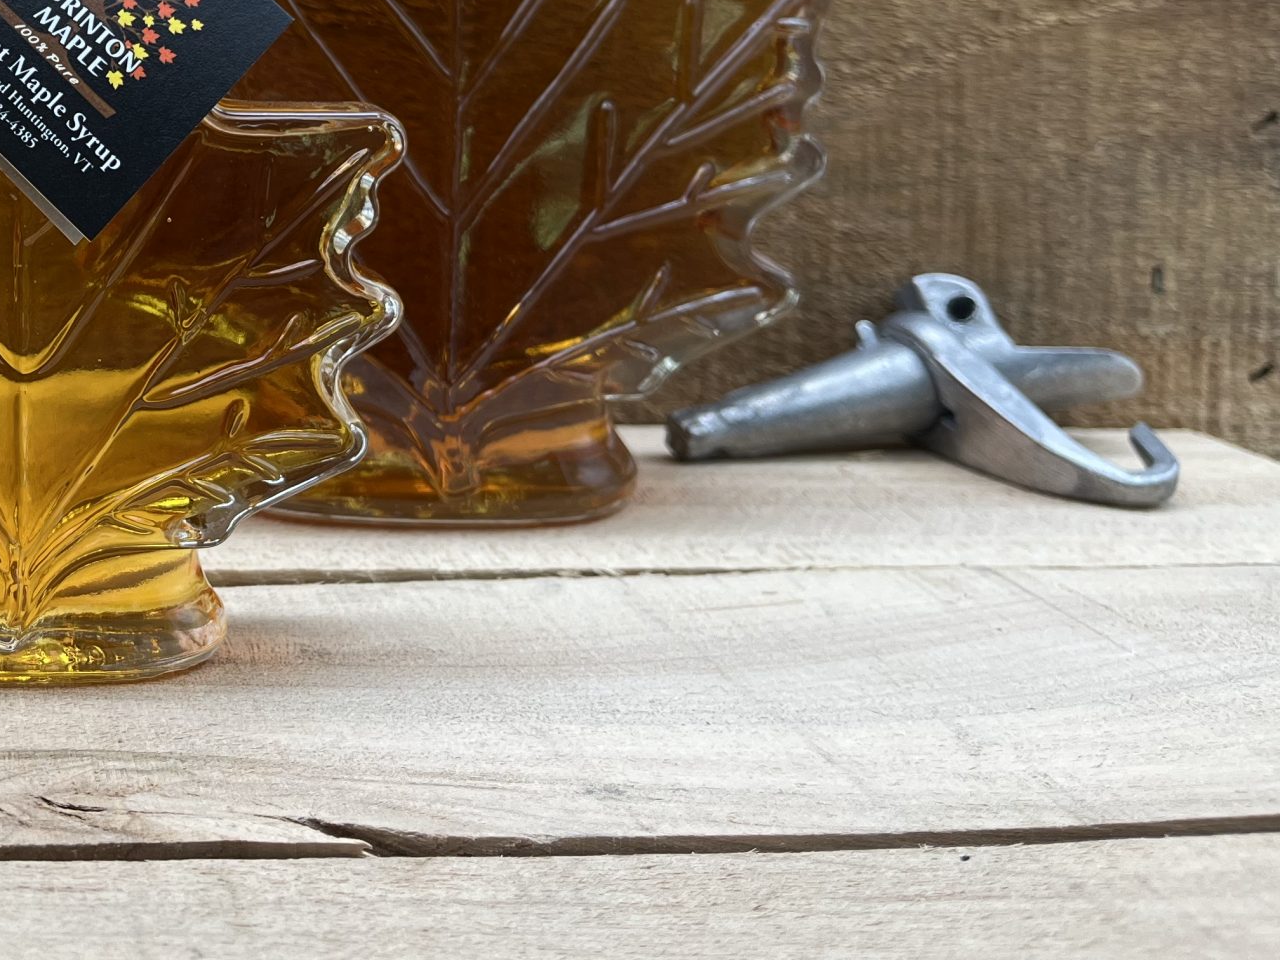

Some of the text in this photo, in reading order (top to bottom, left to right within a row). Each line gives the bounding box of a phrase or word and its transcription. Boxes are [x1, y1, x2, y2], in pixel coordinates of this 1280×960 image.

[14, 24, 80, 85] 100% Pure
[33, 6, 109, 78] MAPLE
[7, 89, 70, 158] Huntington,
[73, 152, 94, 173] VT
[8, 54, 67, 117] Maple
[65, 112, 121, 173] Syrup
